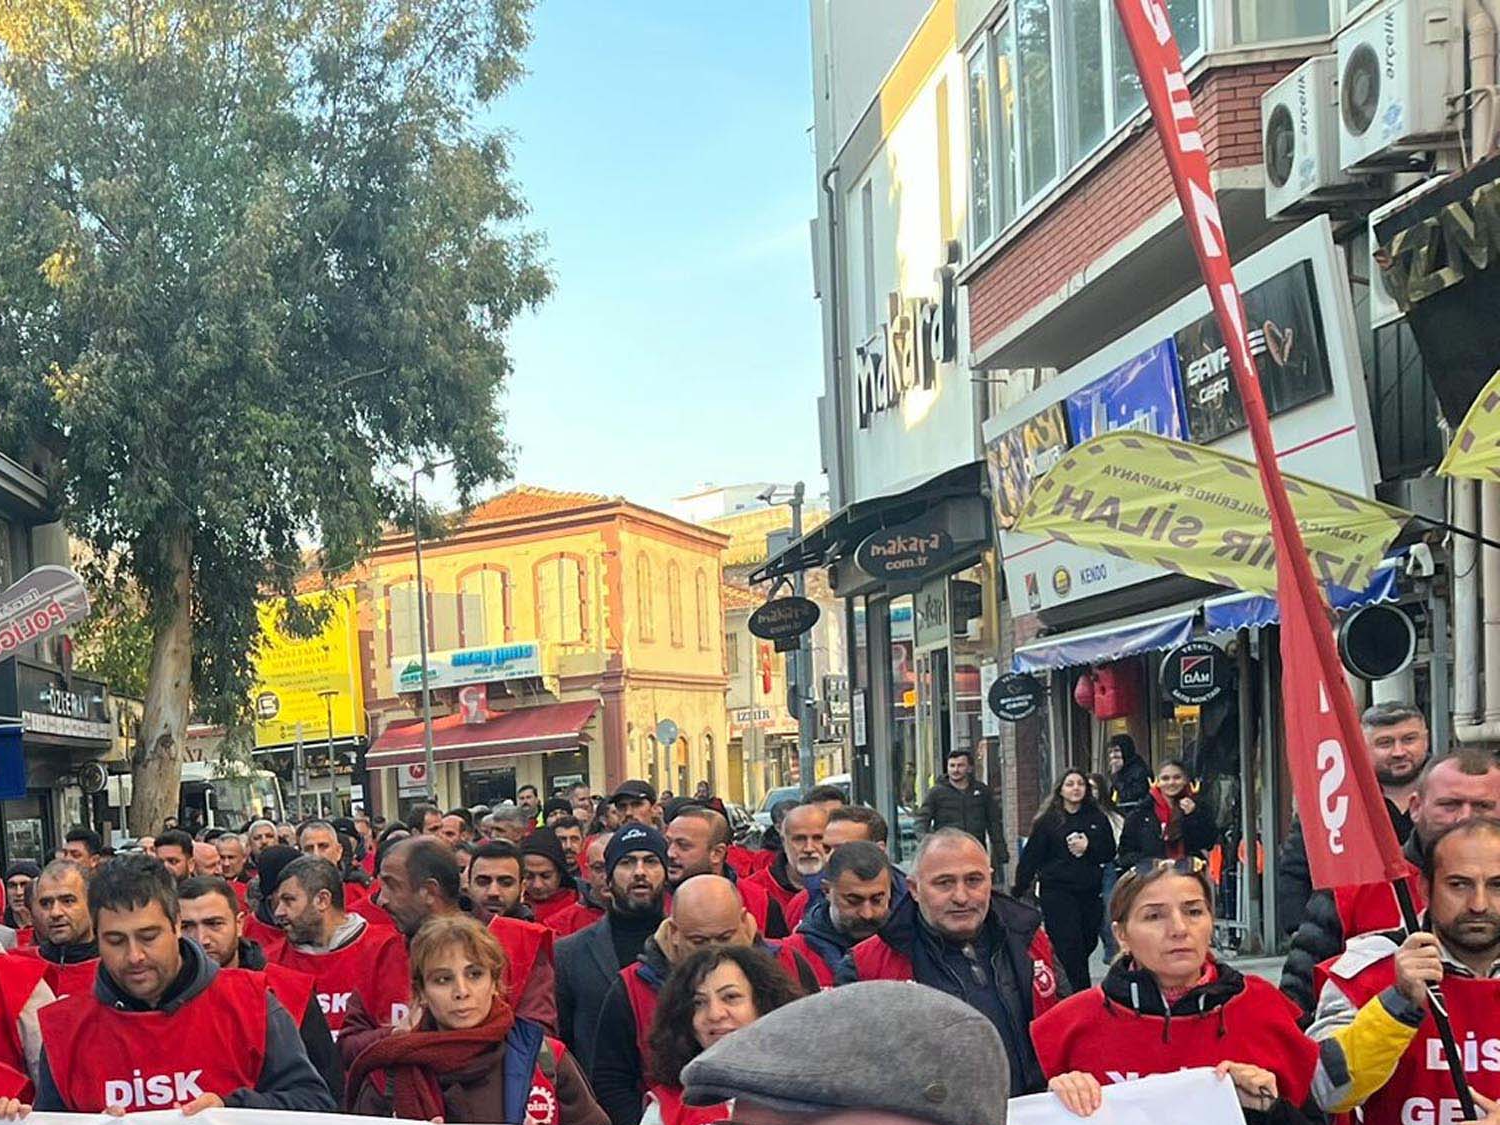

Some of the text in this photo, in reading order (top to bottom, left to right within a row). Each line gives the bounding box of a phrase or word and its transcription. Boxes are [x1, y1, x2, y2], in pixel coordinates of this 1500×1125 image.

[1385, 11, 1404, 80] arçelik
[1199, 377, 1230, 404] GEAR
[871, 533, 940, 558] makara
[885, 556, 929, 571] com.tr
[1080, 563, 1107, 584] KENDO
[1426, 1032, 1500, 1073] DİS
[104, 1069, 205, 1111] DİSK
